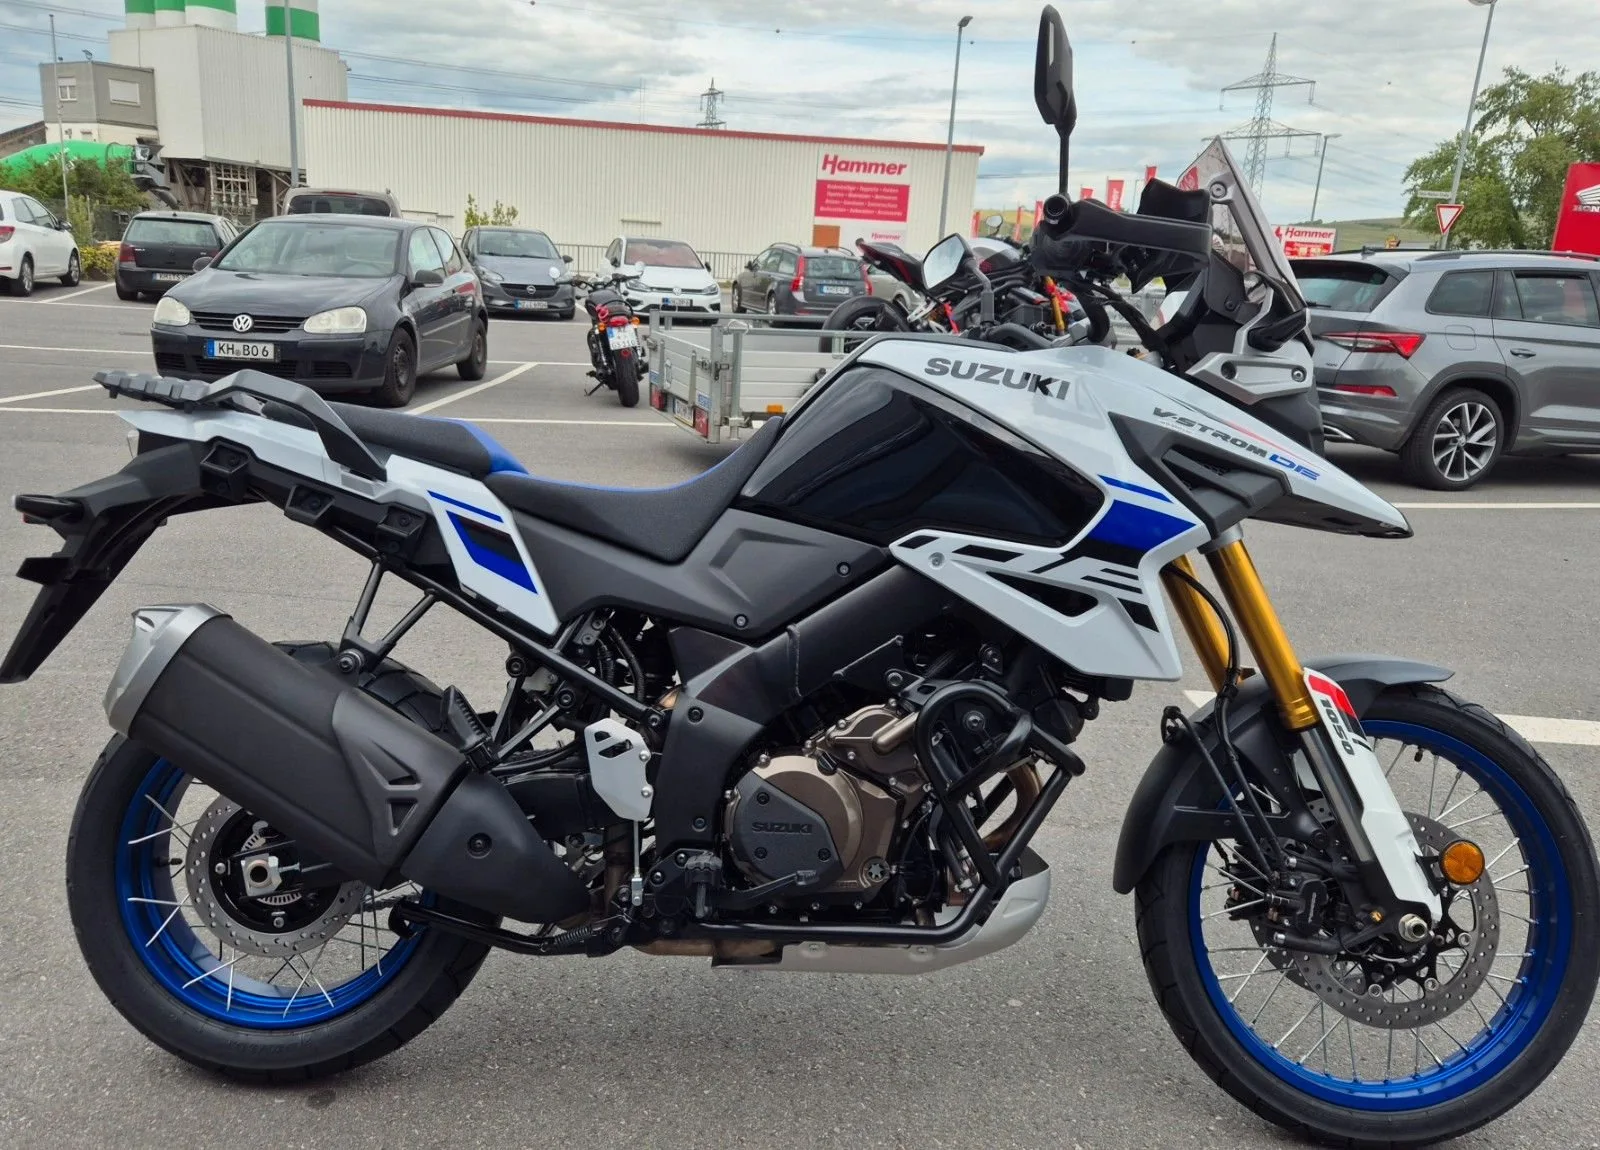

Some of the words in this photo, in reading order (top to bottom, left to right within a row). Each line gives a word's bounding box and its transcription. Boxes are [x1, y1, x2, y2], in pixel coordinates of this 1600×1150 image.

[822, 153, 907, 176] Hammer
[871, 232, 901, 241] Hammer
[1285, 226, 1334, 238] Hammer
[218, 342, 234, 355] KH
[261, 345, 269, 357] 6
[924, 357, 1071, 401] SUZUKI
[1152, 406, 1268, 458] V-STROM
[1269, 453, 1321, 481] DE
[1319, 697, 1355, 756] 1050
[751, 821, 813, 834] SUZUKI
